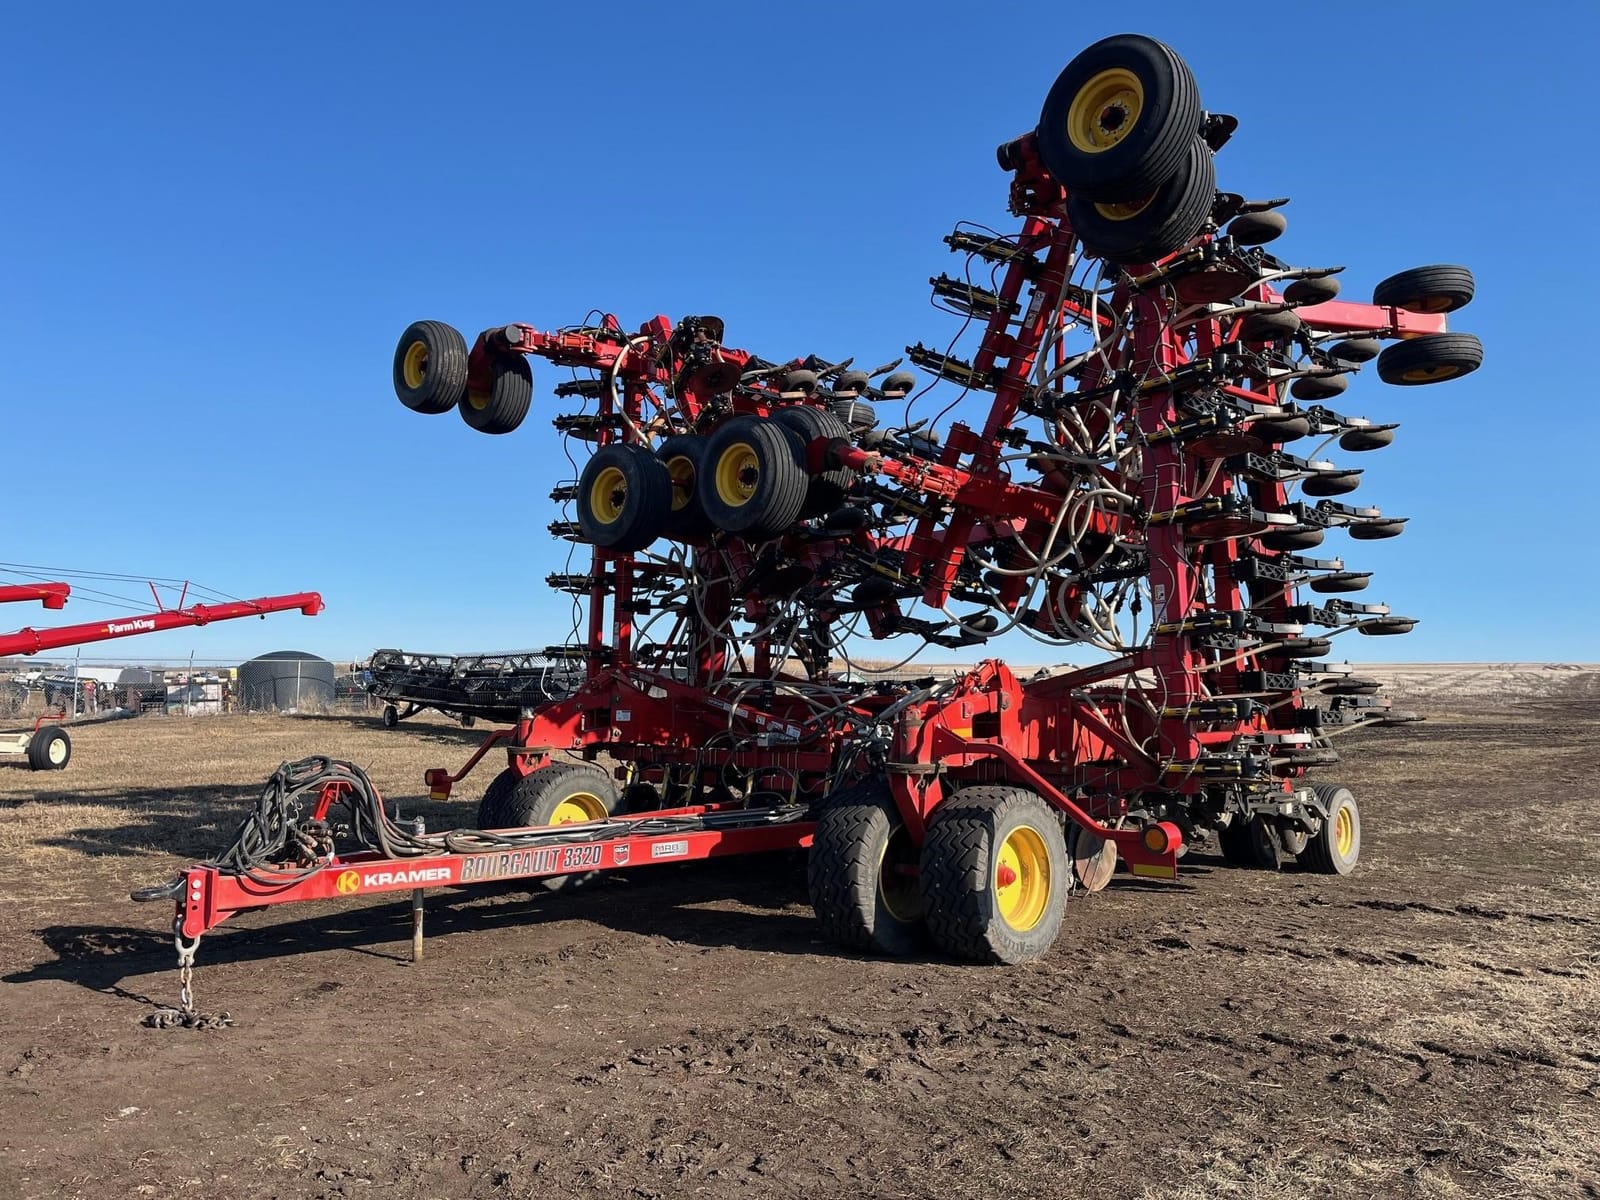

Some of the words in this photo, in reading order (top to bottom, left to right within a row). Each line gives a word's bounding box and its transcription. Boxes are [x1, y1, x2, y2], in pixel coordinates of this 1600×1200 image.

[108, 623, 134, 634] Farm
[133, 620, 155, 630] King
[461, 849, 561, 881] BOURGAULT
[564, 845, 602, 867] 3320
[364, 867, 451, 887] KRAMER
